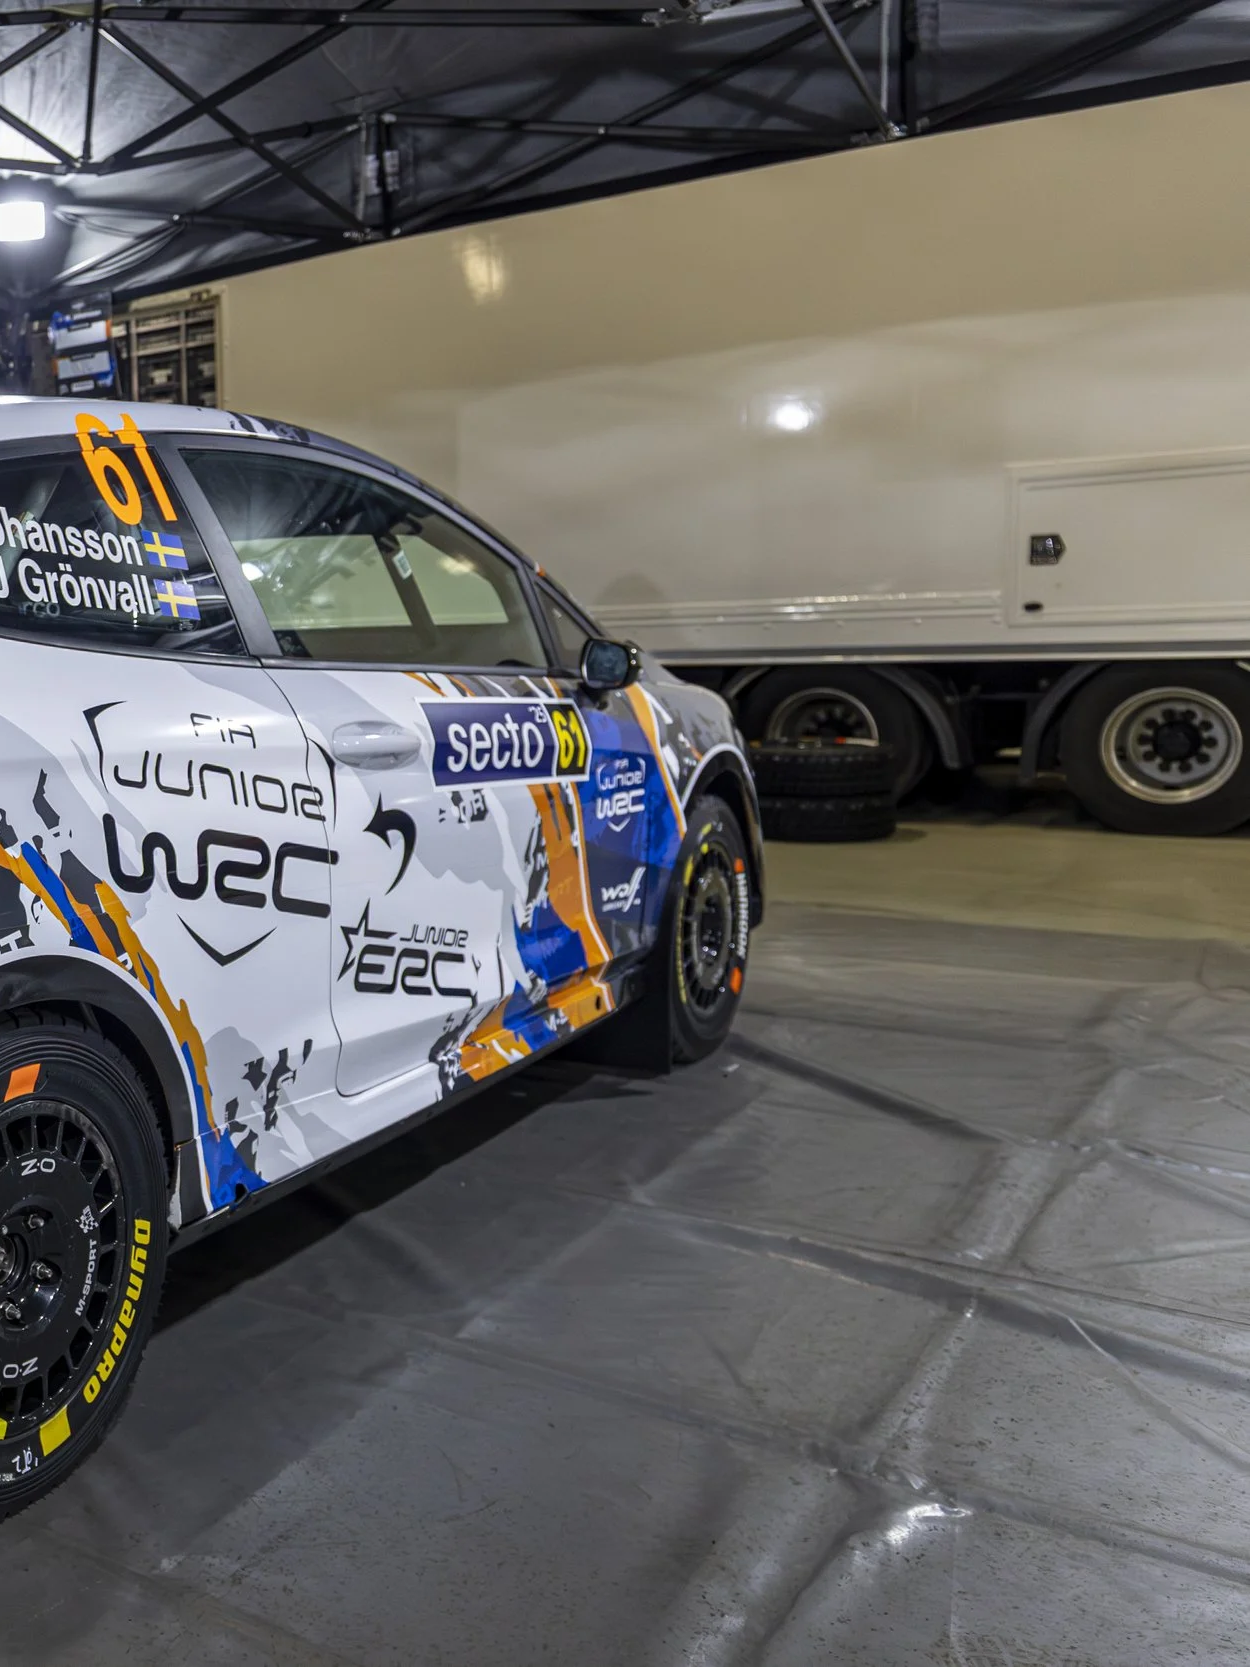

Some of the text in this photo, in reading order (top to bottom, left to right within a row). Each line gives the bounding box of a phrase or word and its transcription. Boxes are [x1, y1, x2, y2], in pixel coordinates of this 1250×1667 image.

[75, 413, 178, 526] 61
[17, 557, 155, 615] Grönvall
[190, 712, 257, 749] FIA
[447, 713, 545, 773] secto
[551, 710, 587, 770] 61
[113, 750, 328, 822] JUNIOR
[596, 788, 646, 820] WRC
[102, 813, 339, 918] WRC
[399, 923, 470, 949] JUNIOR
[354, 943, 476, 999] ERC
[75, 1238, 98, 1317] M-SPORT
